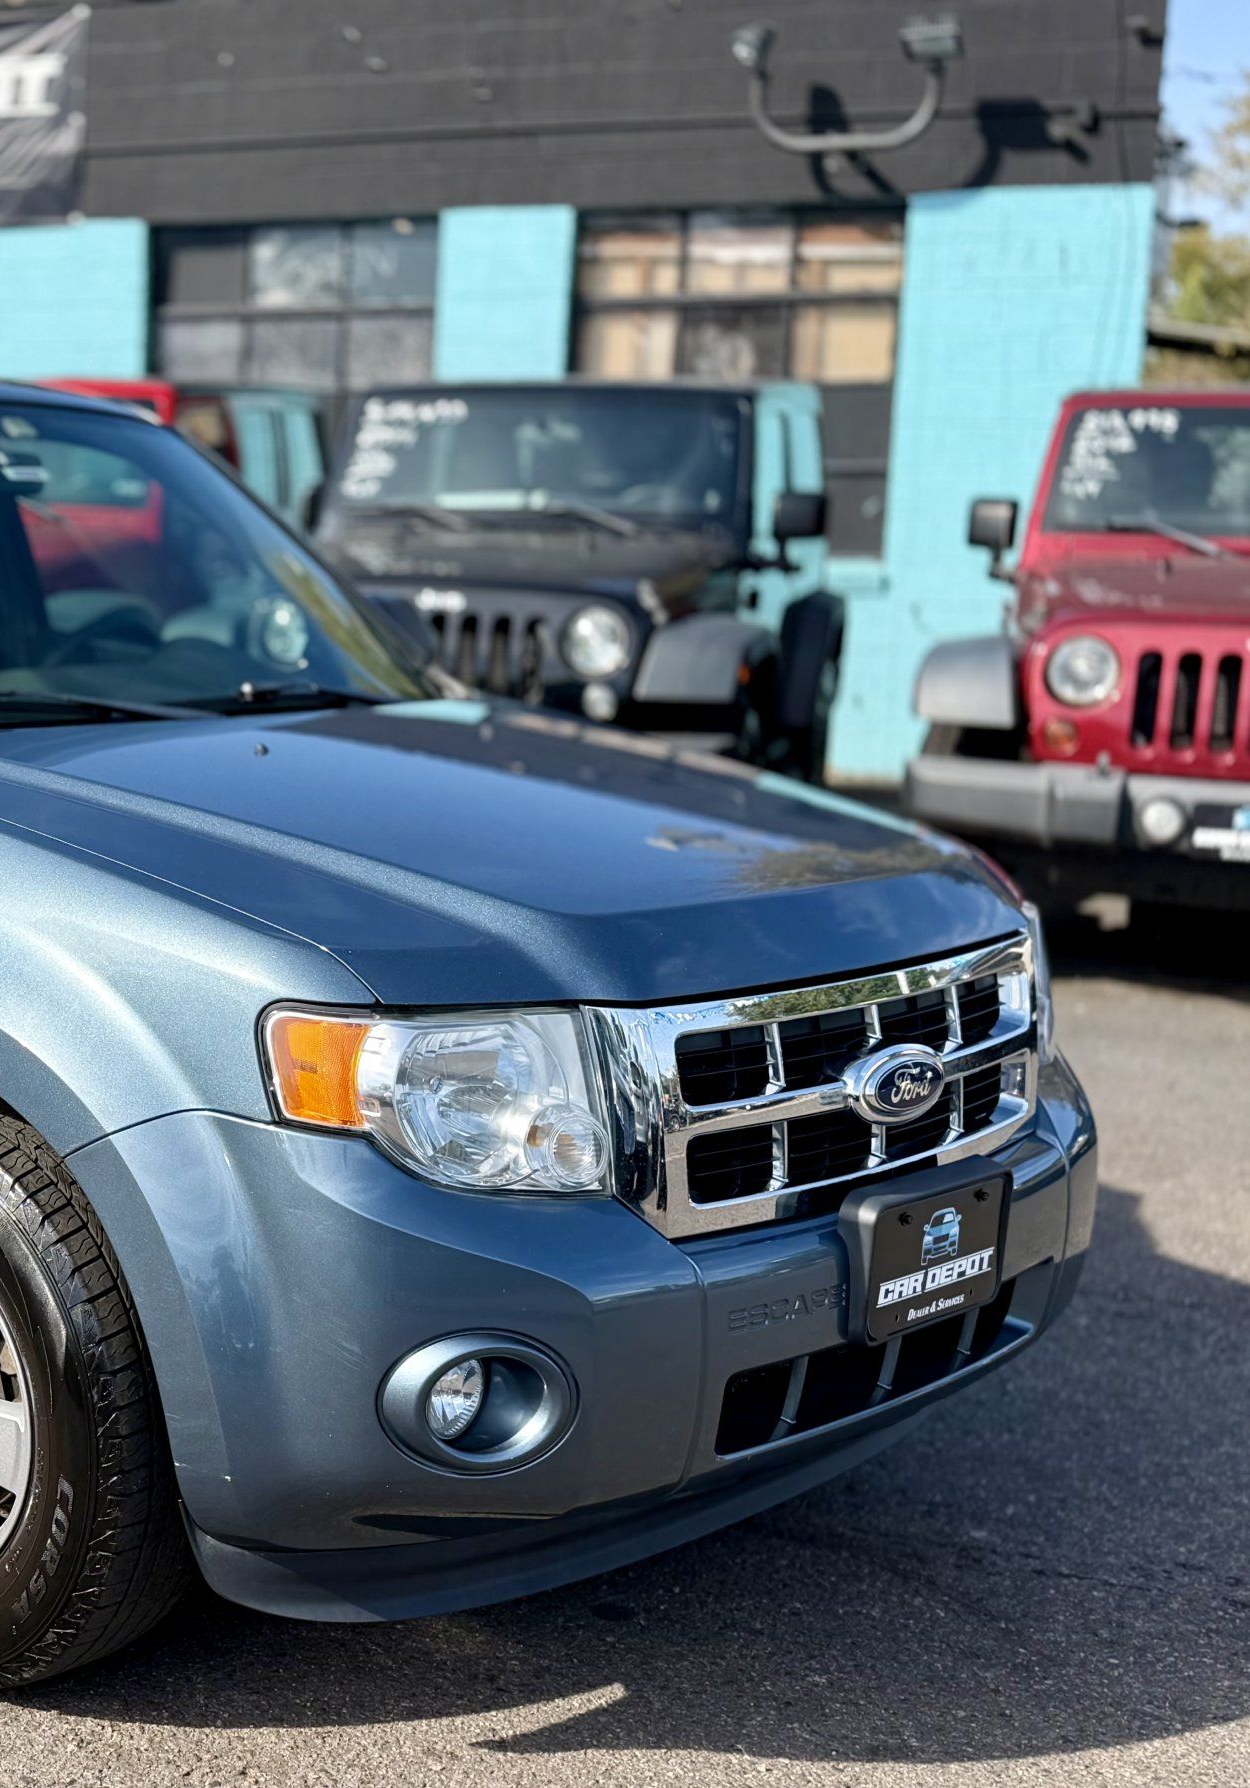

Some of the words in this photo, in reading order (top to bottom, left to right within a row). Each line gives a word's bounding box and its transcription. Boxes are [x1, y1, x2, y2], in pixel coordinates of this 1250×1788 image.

[891, 1065, 933, 1104] Ford
[877, 1273, 924, 1305] CAR
[924, 1250, 994, 1289] DEPOT
[728, 1284, 846, 1335] ESCAPE
